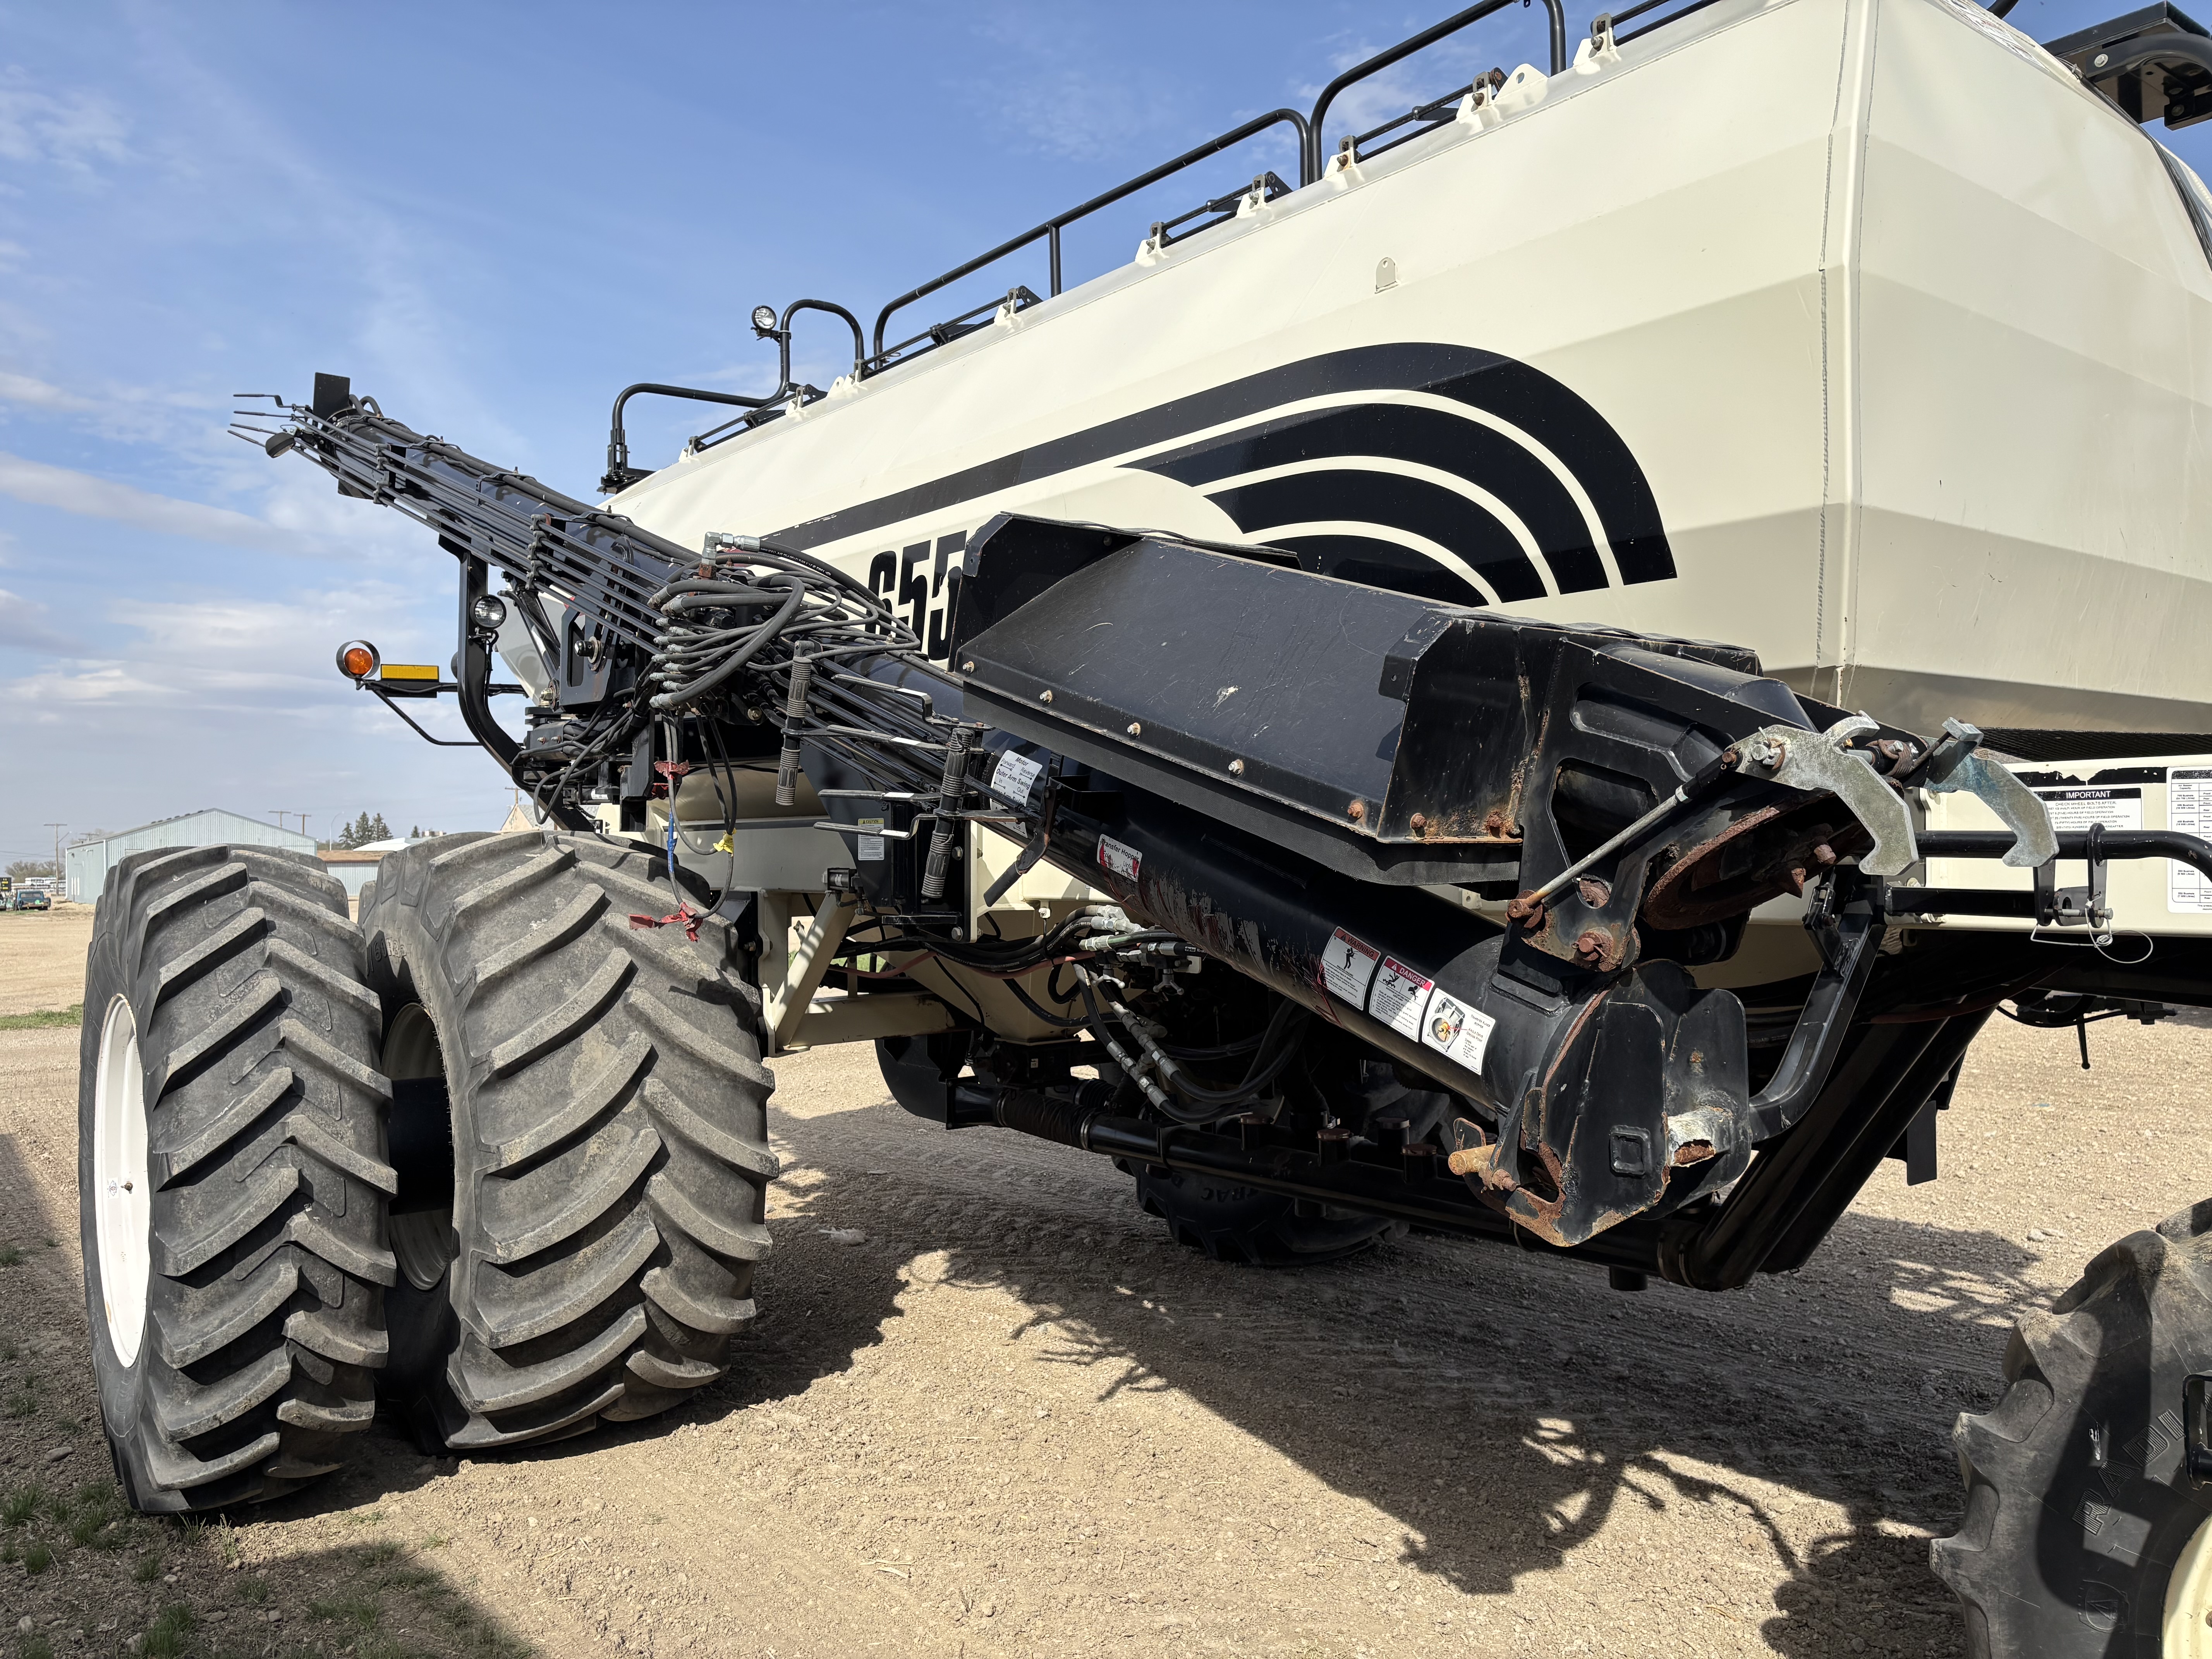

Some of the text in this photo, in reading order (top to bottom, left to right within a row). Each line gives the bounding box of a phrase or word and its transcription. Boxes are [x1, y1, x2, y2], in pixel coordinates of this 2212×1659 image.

[1001, 758, 1035, 778] Forward Reverse
[1015, 757, 1029, 766] Motor
[996, 768, 1030, 790] Outer Arm Swing
[2066, 791, 2111, 799] IMPORTANT
[1348, 936, 1374, 957] WARNING
[1399, 968, 1425, 987] DANGER
[2072, 1409, 2186, 1536] RADI
